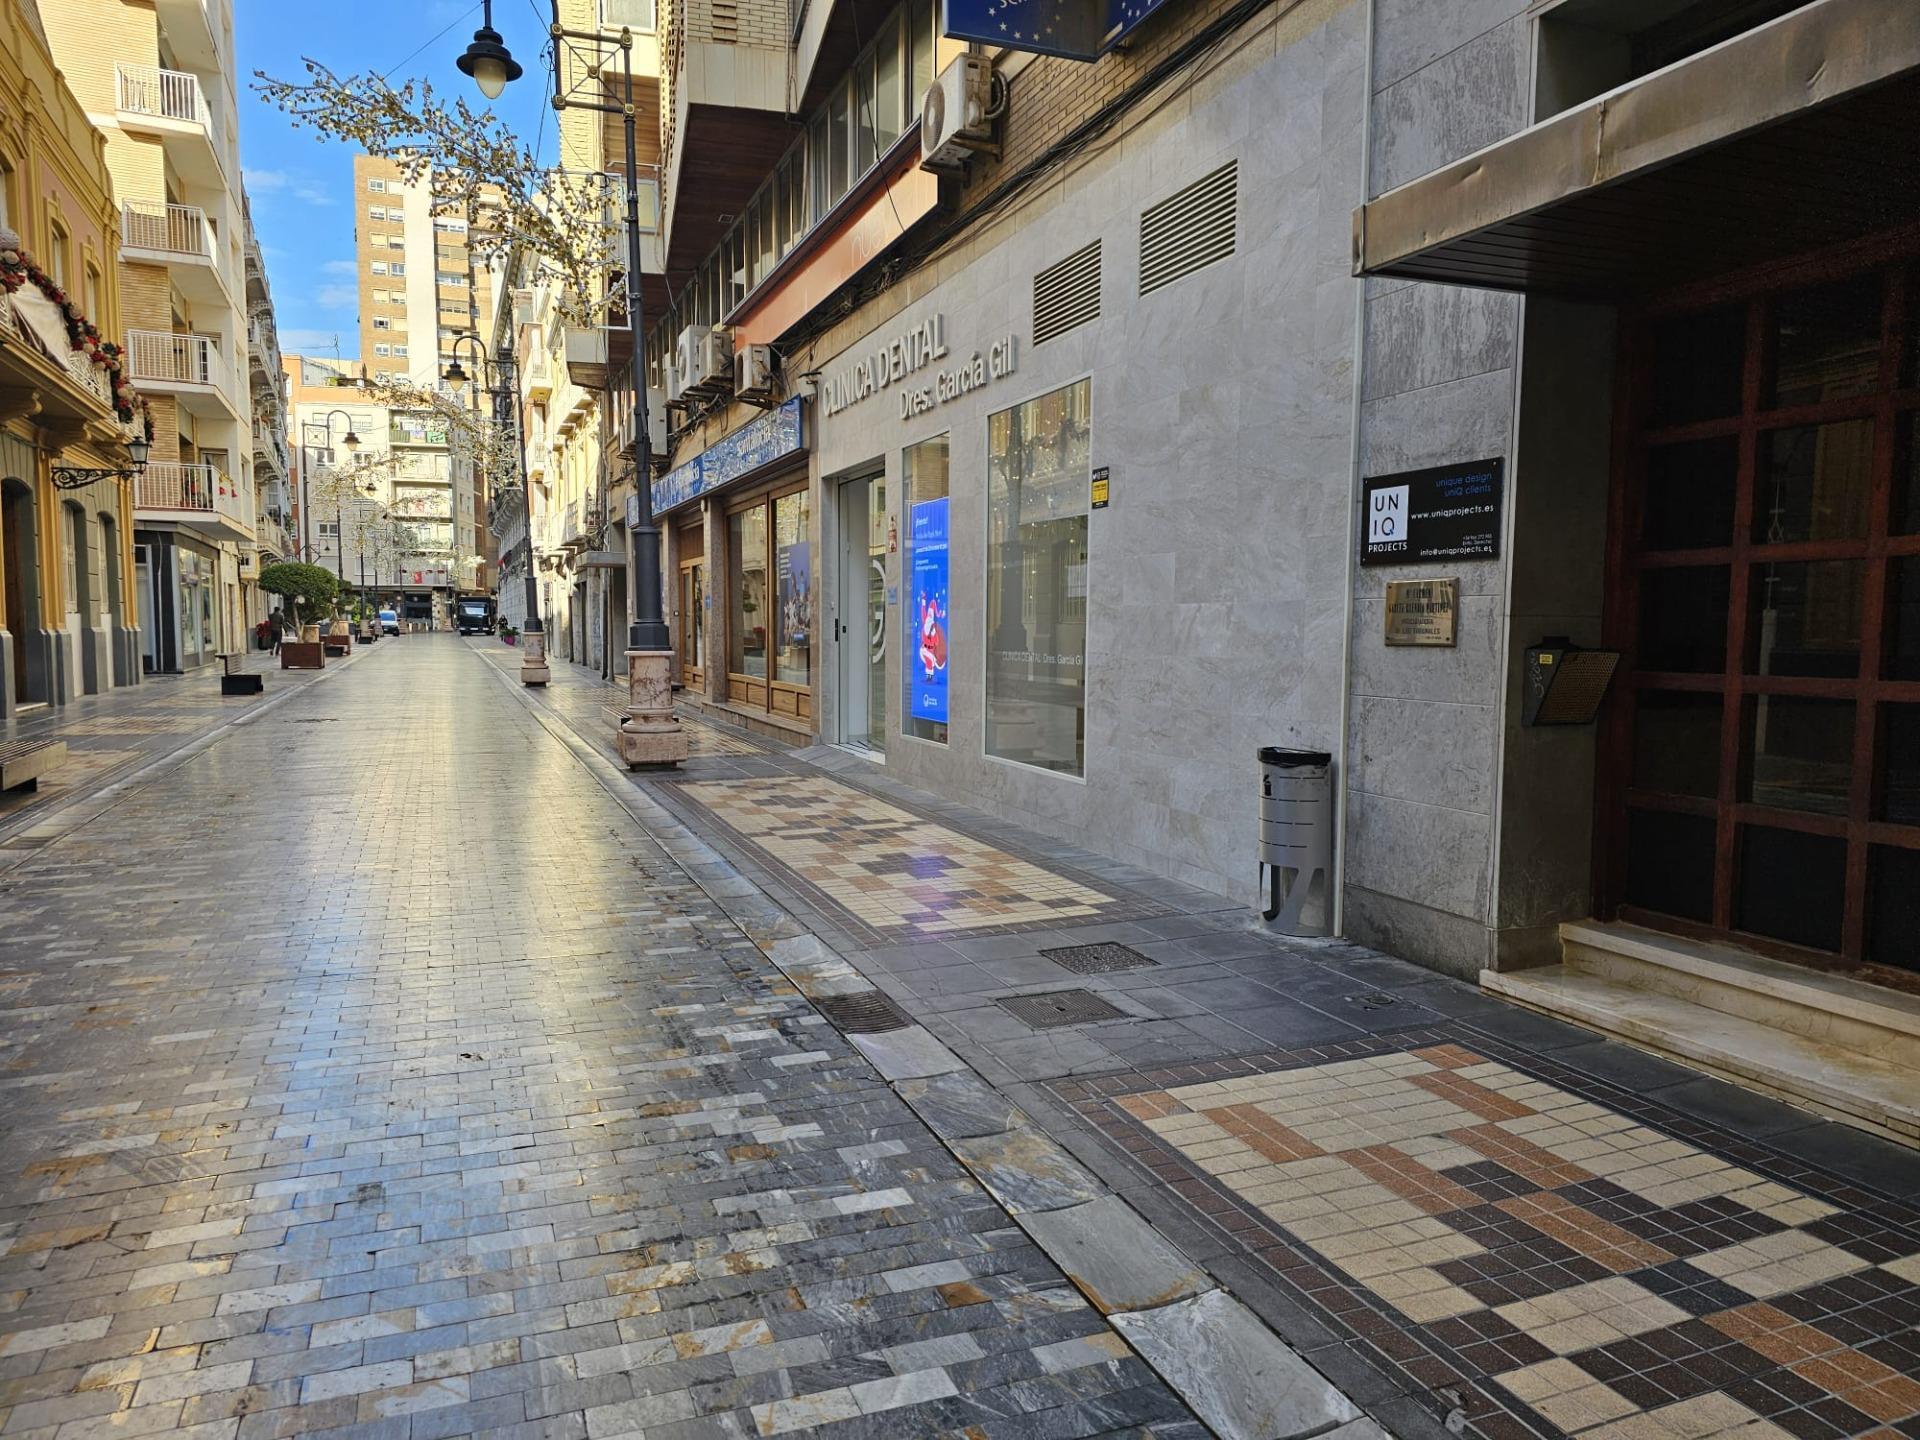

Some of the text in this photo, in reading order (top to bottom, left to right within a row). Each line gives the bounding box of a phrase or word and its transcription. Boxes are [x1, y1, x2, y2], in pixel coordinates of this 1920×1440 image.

[822, 313, 948, 417] CLINICA DENTAL
[900, 332, 1018, 420] Dres. García Gil
[1435, 472, 1493, 488] unique design
[1465, 484, 1493, 495] clients
[1375, 492, 1399, 512] UN
[1410, 504, 1494, 520] www.uniqprojects.es
[1373, 516, 1395, 536] IQ
[1368, 541, 1408, 553] PROJECTS
[1420, 544, 1493, 557] info@uniqprojects.es
